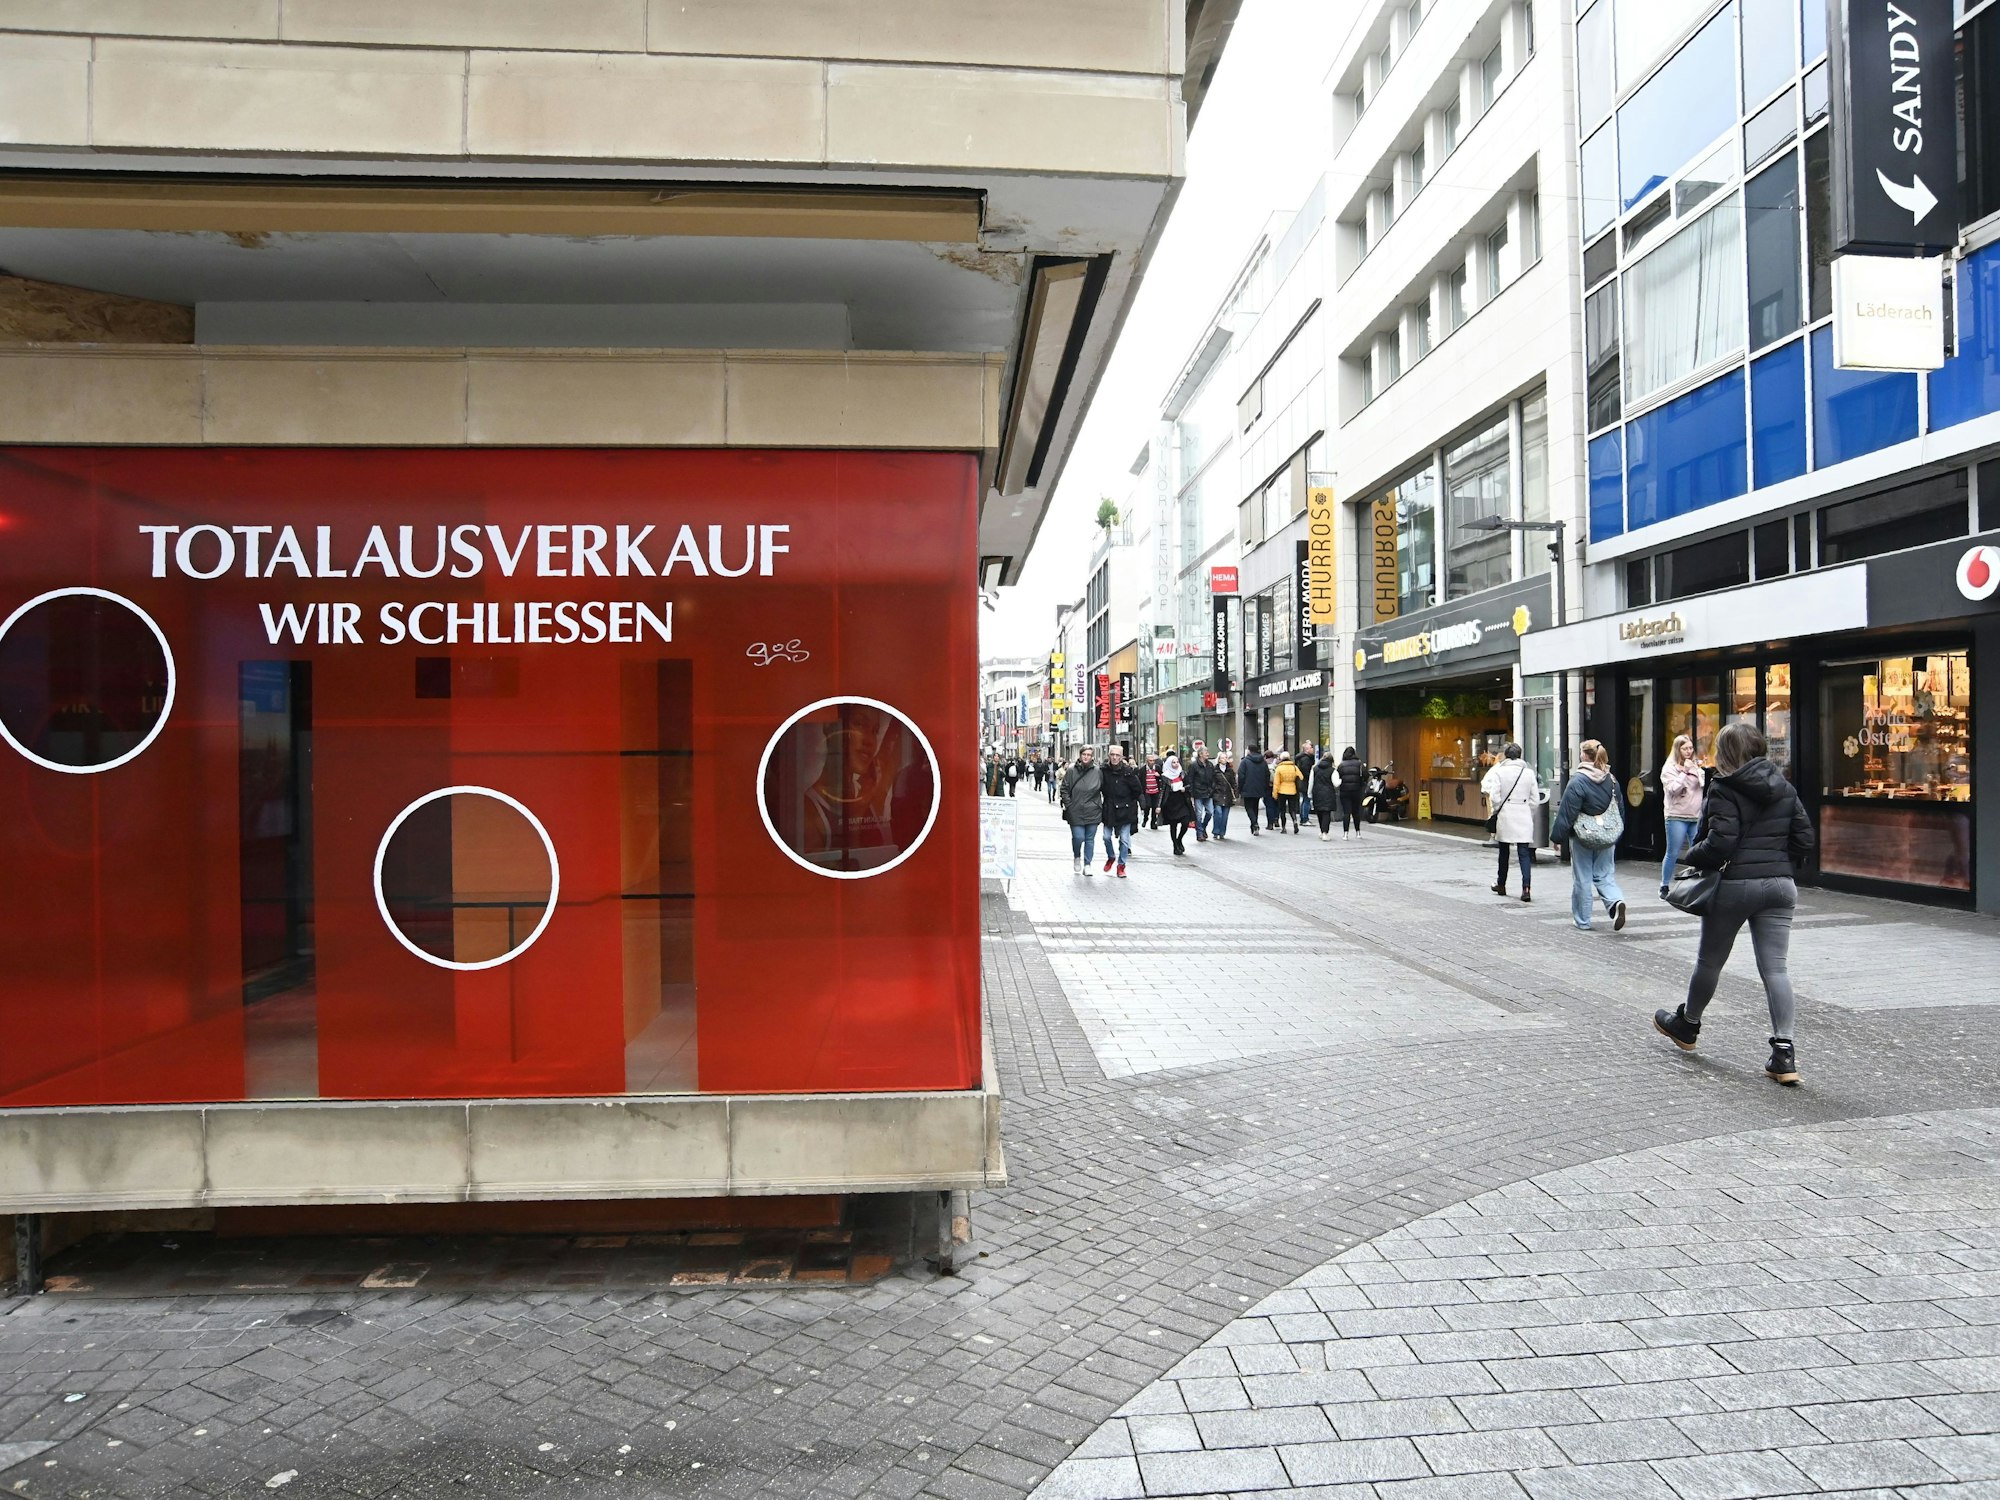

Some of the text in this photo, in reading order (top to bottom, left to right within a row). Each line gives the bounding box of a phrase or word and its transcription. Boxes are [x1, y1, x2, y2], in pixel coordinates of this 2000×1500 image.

[1886, 2, 1924, 155] SANDY
[1856, 302, 1932, 321] Läderach
[138, 523, 791, 580] TOTALAUSVERKAUF
[1310, 508, 1332, 615] CHURROS
[1212, 573, 1236, 582] HEMA
[258, 601, 674, 645] WIR SCHLIESSEN
[1217, 611, 1226, 673] JACK&JONES
[1618, 610, 1683, 641] Läderach
[1074, 663, 1085, 704] claire's
